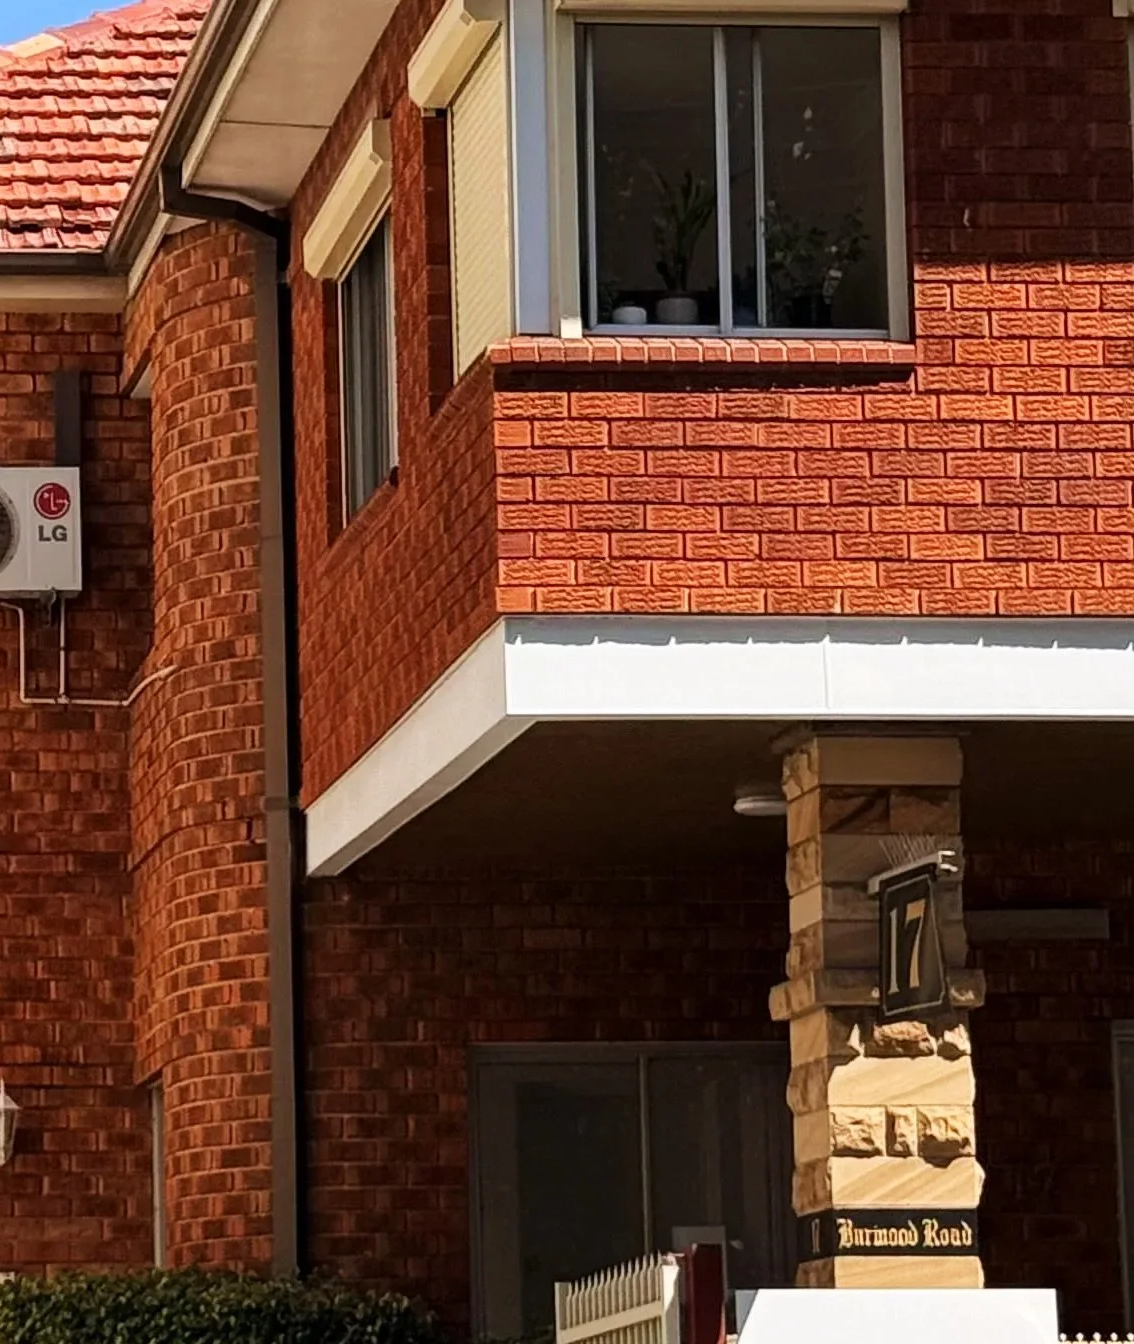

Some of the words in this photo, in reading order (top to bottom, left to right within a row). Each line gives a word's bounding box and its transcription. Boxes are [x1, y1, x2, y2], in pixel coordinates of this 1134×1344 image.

[38, 525, 68, 542] LG
[887, 899, 925, 995] 17
[922, 1218, 973, 1248] Road
